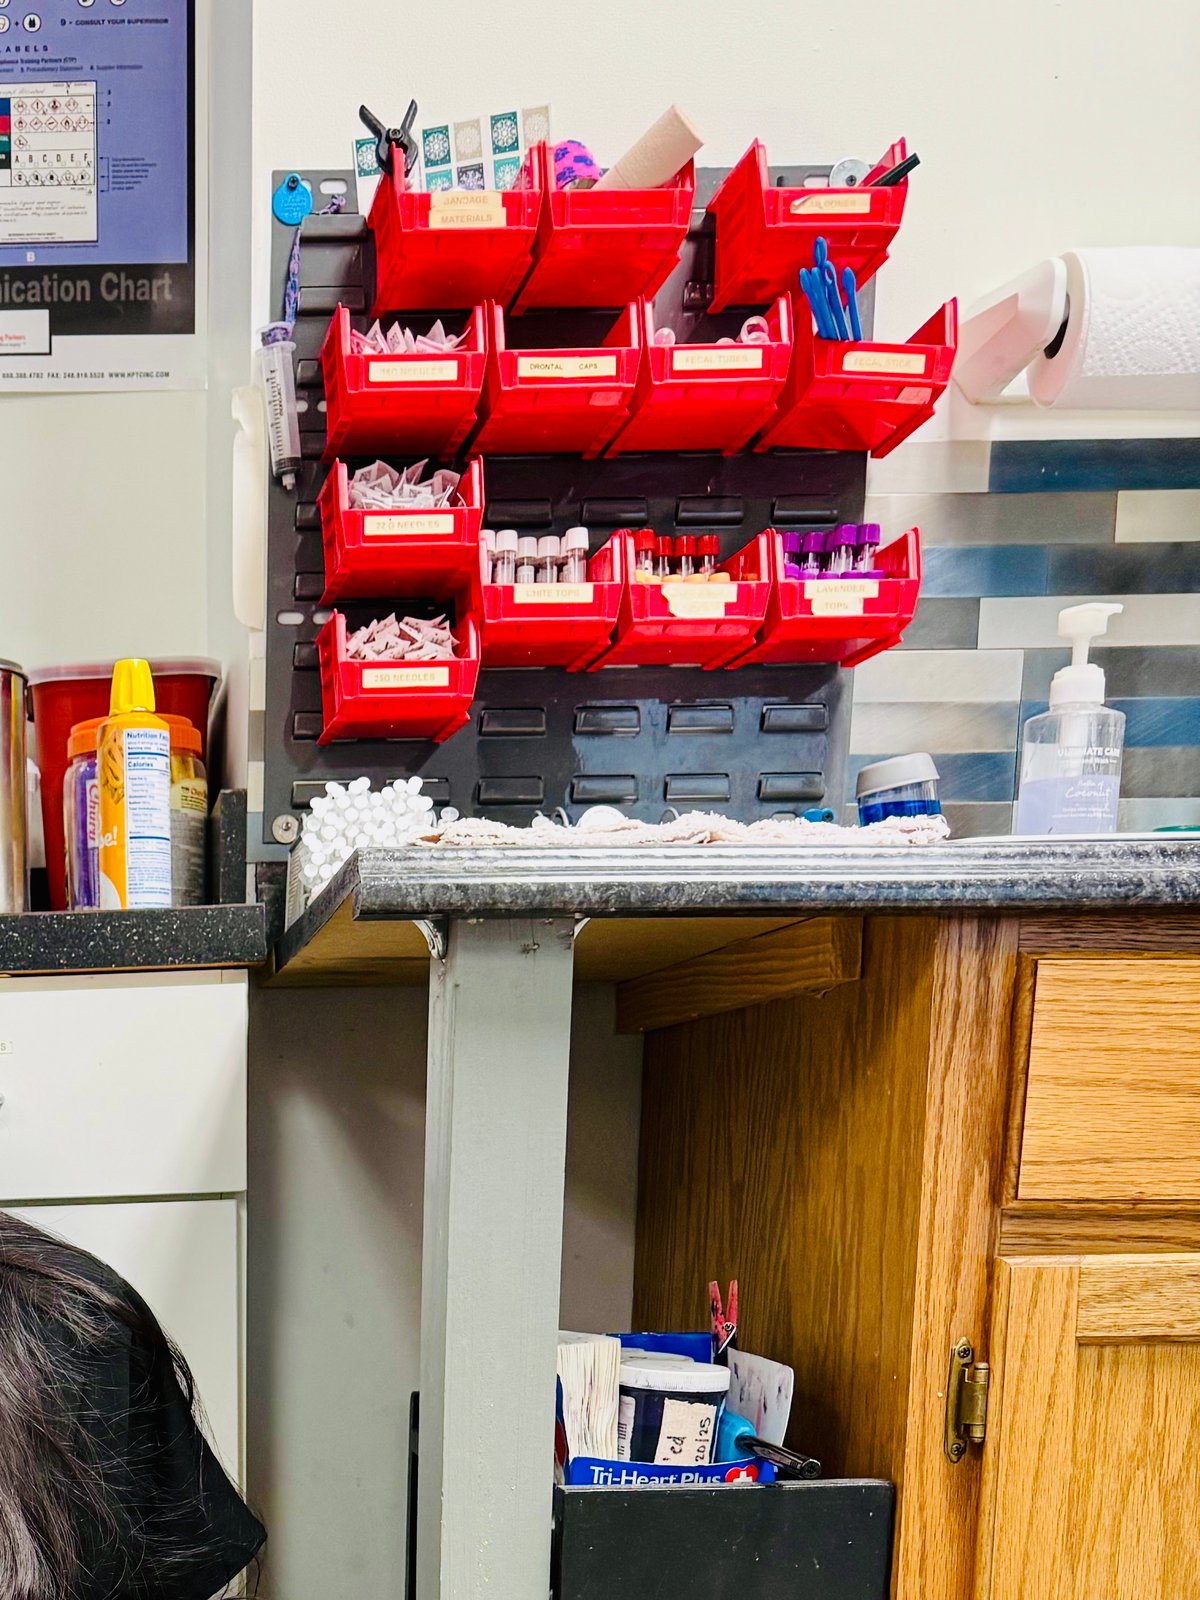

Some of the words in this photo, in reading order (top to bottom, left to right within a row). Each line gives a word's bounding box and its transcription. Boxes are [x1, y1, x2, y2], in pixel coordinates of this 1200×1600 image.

[75, 18, 105, 26] CONSULT
[443, 195, 488, 206] BANDAGE
[441, 213, 493, 224] MATERIALS
[26, 252, 36, 262] B
[101, 272, 173, 301] Chart
[685, 355, 713, 364] FECAL
[717, 354, 748, 364] TUBES
[853, 357, 884, 367] FECAL
[400, 365, 444, 375] NEEDLES
[529, 362, 564, 371] DRONTAL
[578, 362, 598, 371] CAPS
[108, 371, 170, 379] WWW.HPTCINC.COM
[397, 519, 440, 529] NEEDLES
[555, 588, 580, 598] TOPS
[816, 583, 866, 593] LAVENDER
[824, 601, 848, 610] TOPS
[393, 672, 436, 683] NEEDLES
[126, 731, 158, 740] Nutrition
[88, 783, 99, 843] Churu
[590, 1465, 676, 1486] Tri-Heart
[680, 1472, 721, 1485] Plus
